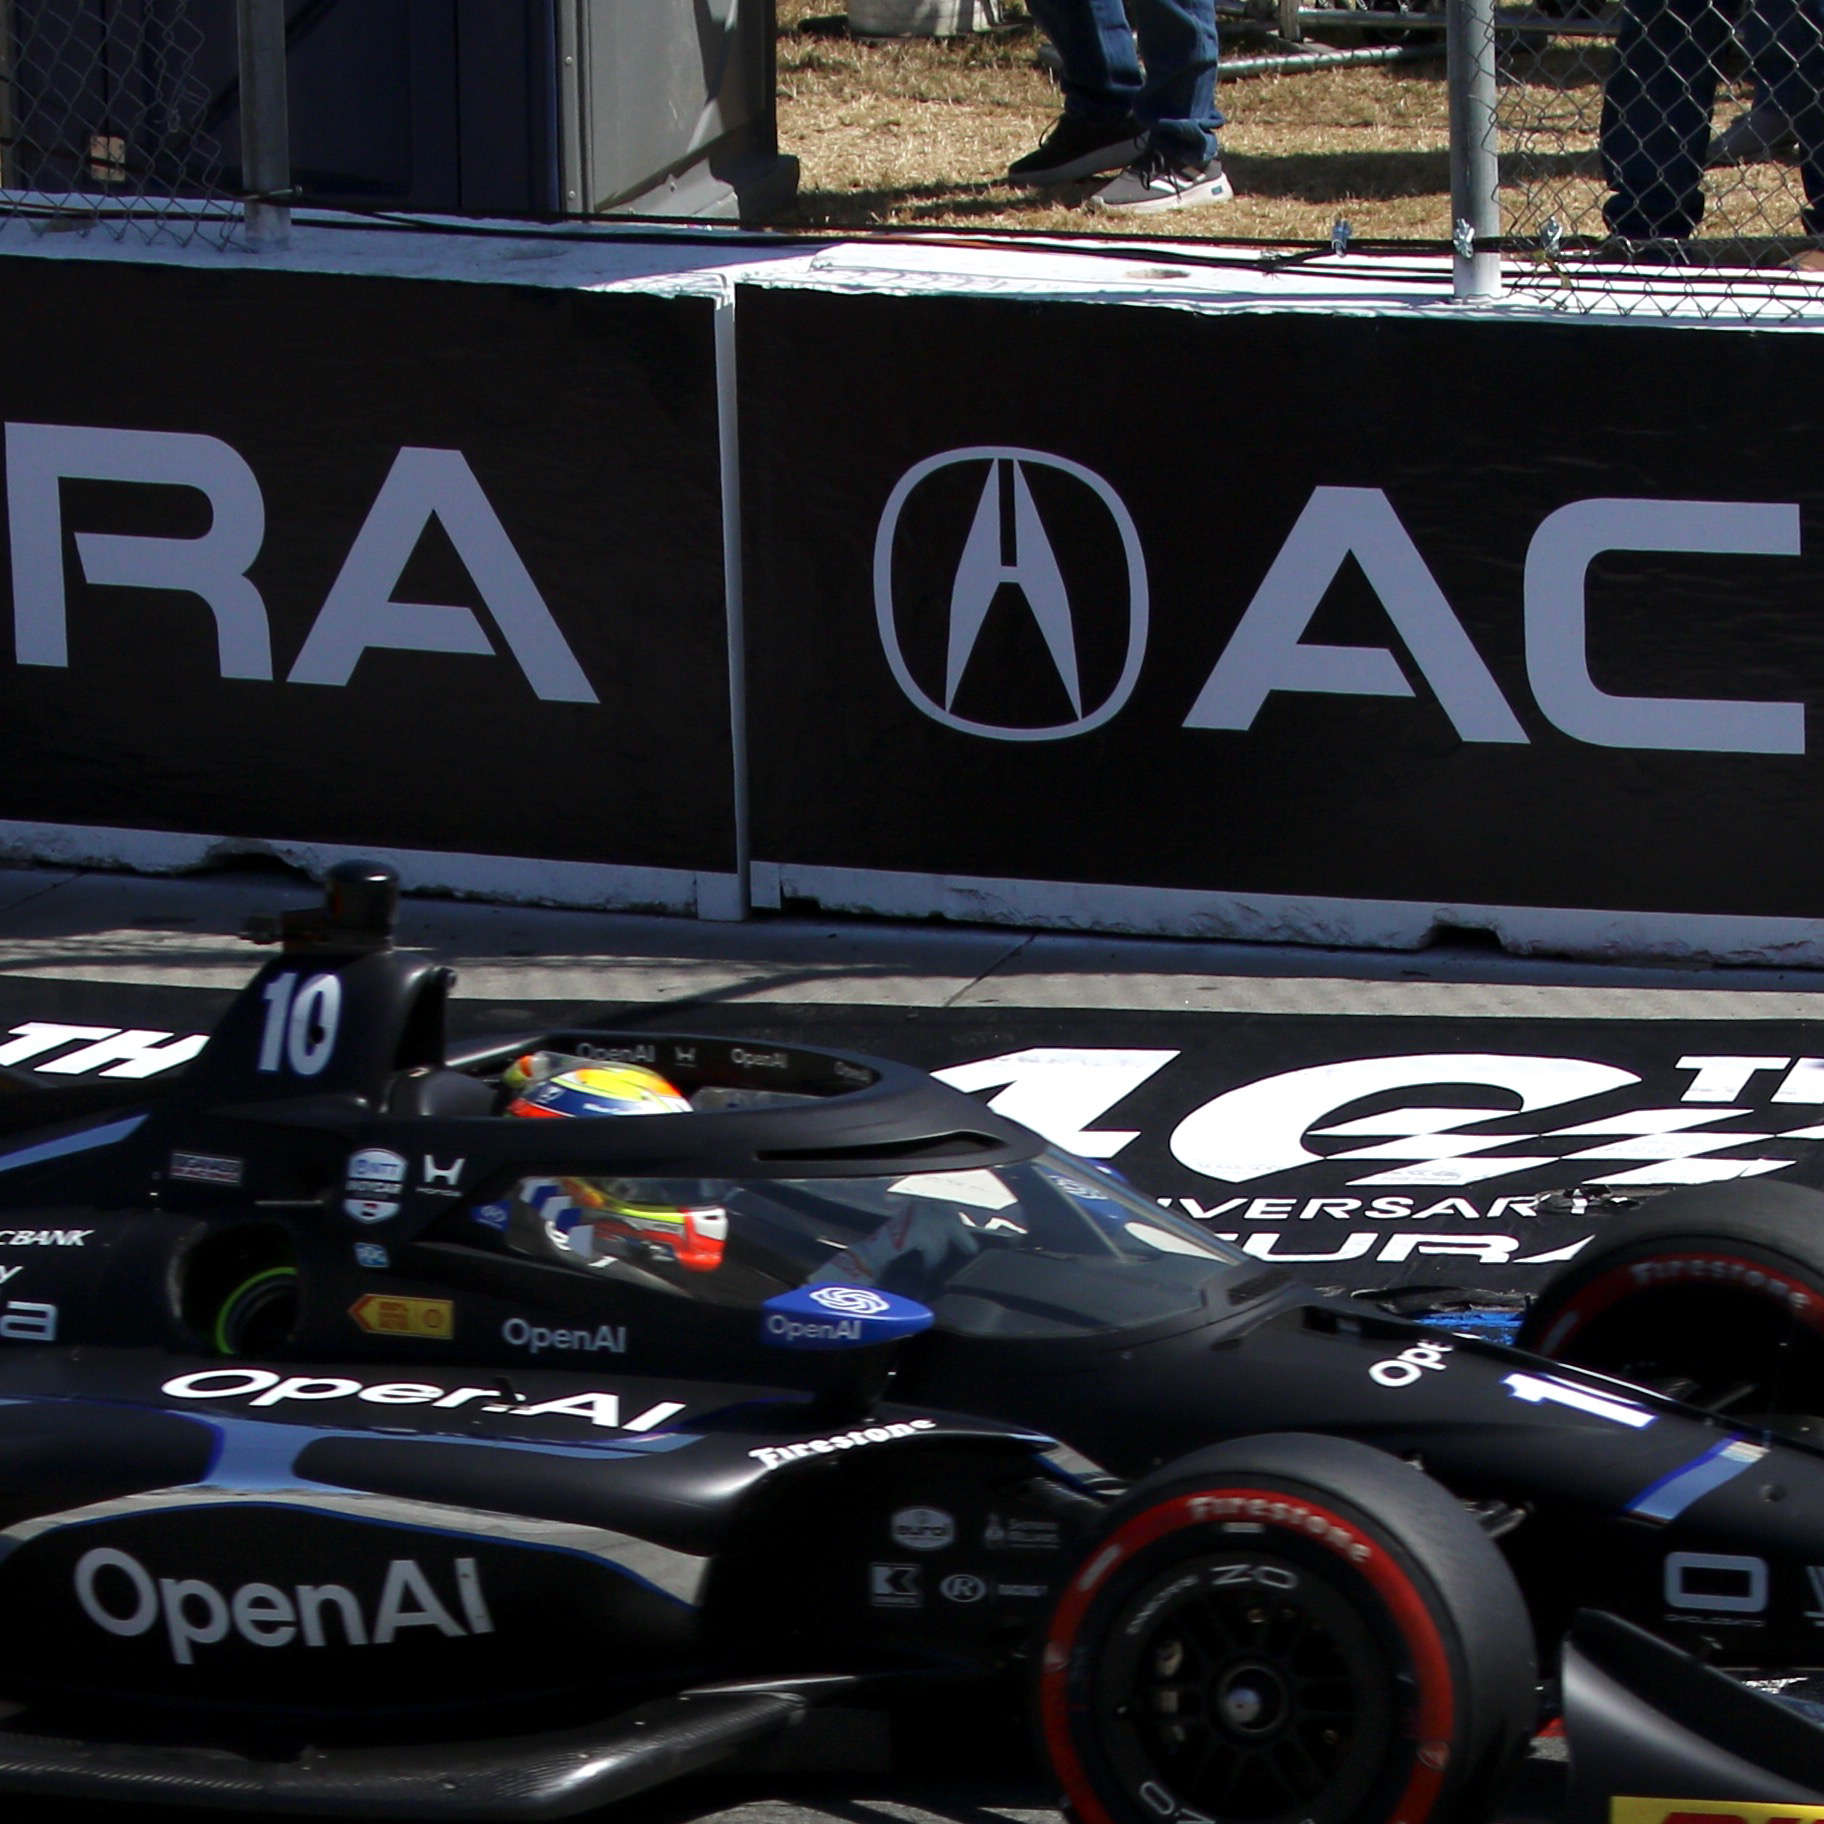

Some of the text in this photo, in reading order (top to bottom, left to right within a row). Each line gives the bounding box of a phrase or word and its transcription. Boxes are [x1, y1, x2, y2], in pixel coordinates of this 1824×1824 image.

[258, 972, 342, 1077] 10
[502, 1317, 626, 1354] OpenAI
[768, 1312, 862, 1341] OpenAI
[750, 1417, 936, 1470] Firestone
[1186, 1495, 1373, 1562] Firestone
[74, 1547, 495, 1665] OpenAI
